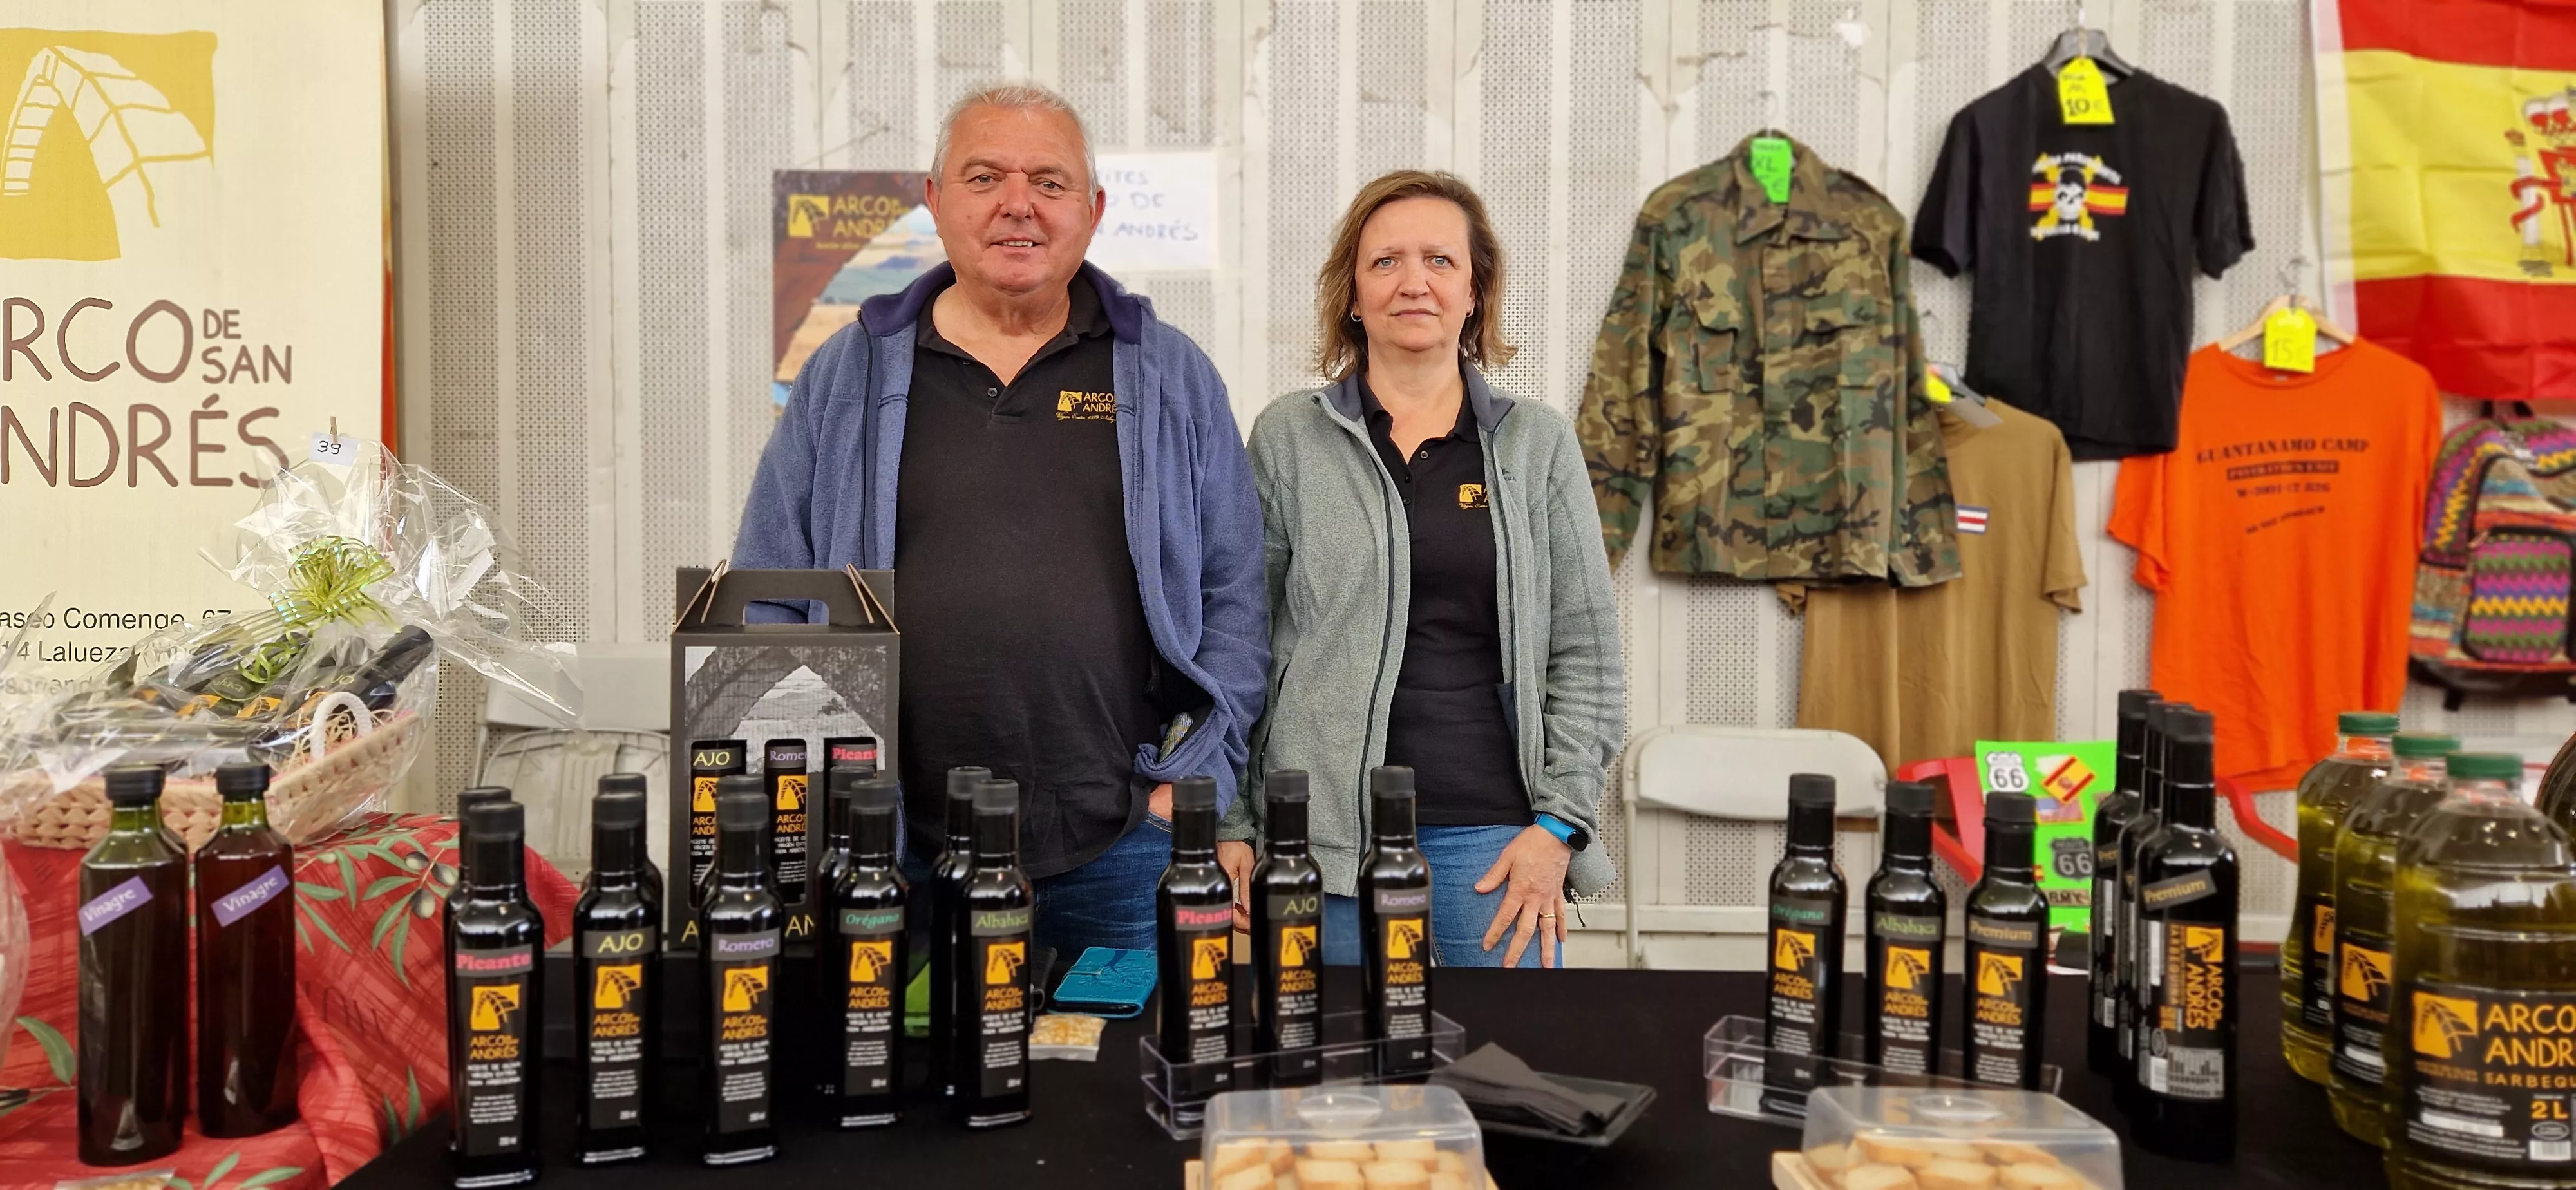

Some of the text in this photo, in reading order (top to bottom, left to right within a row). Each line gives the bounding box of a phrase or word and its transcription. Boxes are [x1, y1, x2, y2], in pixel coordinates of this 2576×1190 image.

[833, 219, 892, 238] ANDR
[2, 298, 243, 383] RCO DE
[202, 345, 293, 384] SAN
[1083, 392, 1113, 403] ARCO
[0, 394, 290, 489] NDRÉS
[317, 440, 342, 455] 39
[2196, 437, 2370, 464] GUANTANAMO CAMP
[693, 751, 730, 766] AJO
[770, 750, 806, 761] Rome
[832, 747, 877, 760] Pican
[1994, 768, 2024, 788] 66
[693, 817, 716, 826] ARC
[776, 822, 806, 833] ANDRÉ
[2058, 853, 2092, 876] 66
[222, 876, 279, 912] Vinagre
[1381, 892, 1426, 906] Romero
[2049, 891, 2085, 904] RMY
[2143, 880, 2206, 903] Premium
[82, 887, 137, 923] Vinagre
[1283, 896, 1318, 916] AJO
[845, 912, 900, 930] Orégano
[974, 911, 1029, 929] Albahaca
[1876, 916, 1937, 935] Albahaca
[1969, 919, 2033, 941] Premium
[597, 933, 643, 954] AJO
[718, 938, 775, 952] Romero
[455, 953, 531, 970] Picante
[2206, 963, 2224, 1012] ARCO
[2485, 1003, 2576, 1034] ARCO
[2485, 1037, 2576, 1068] ANDR
